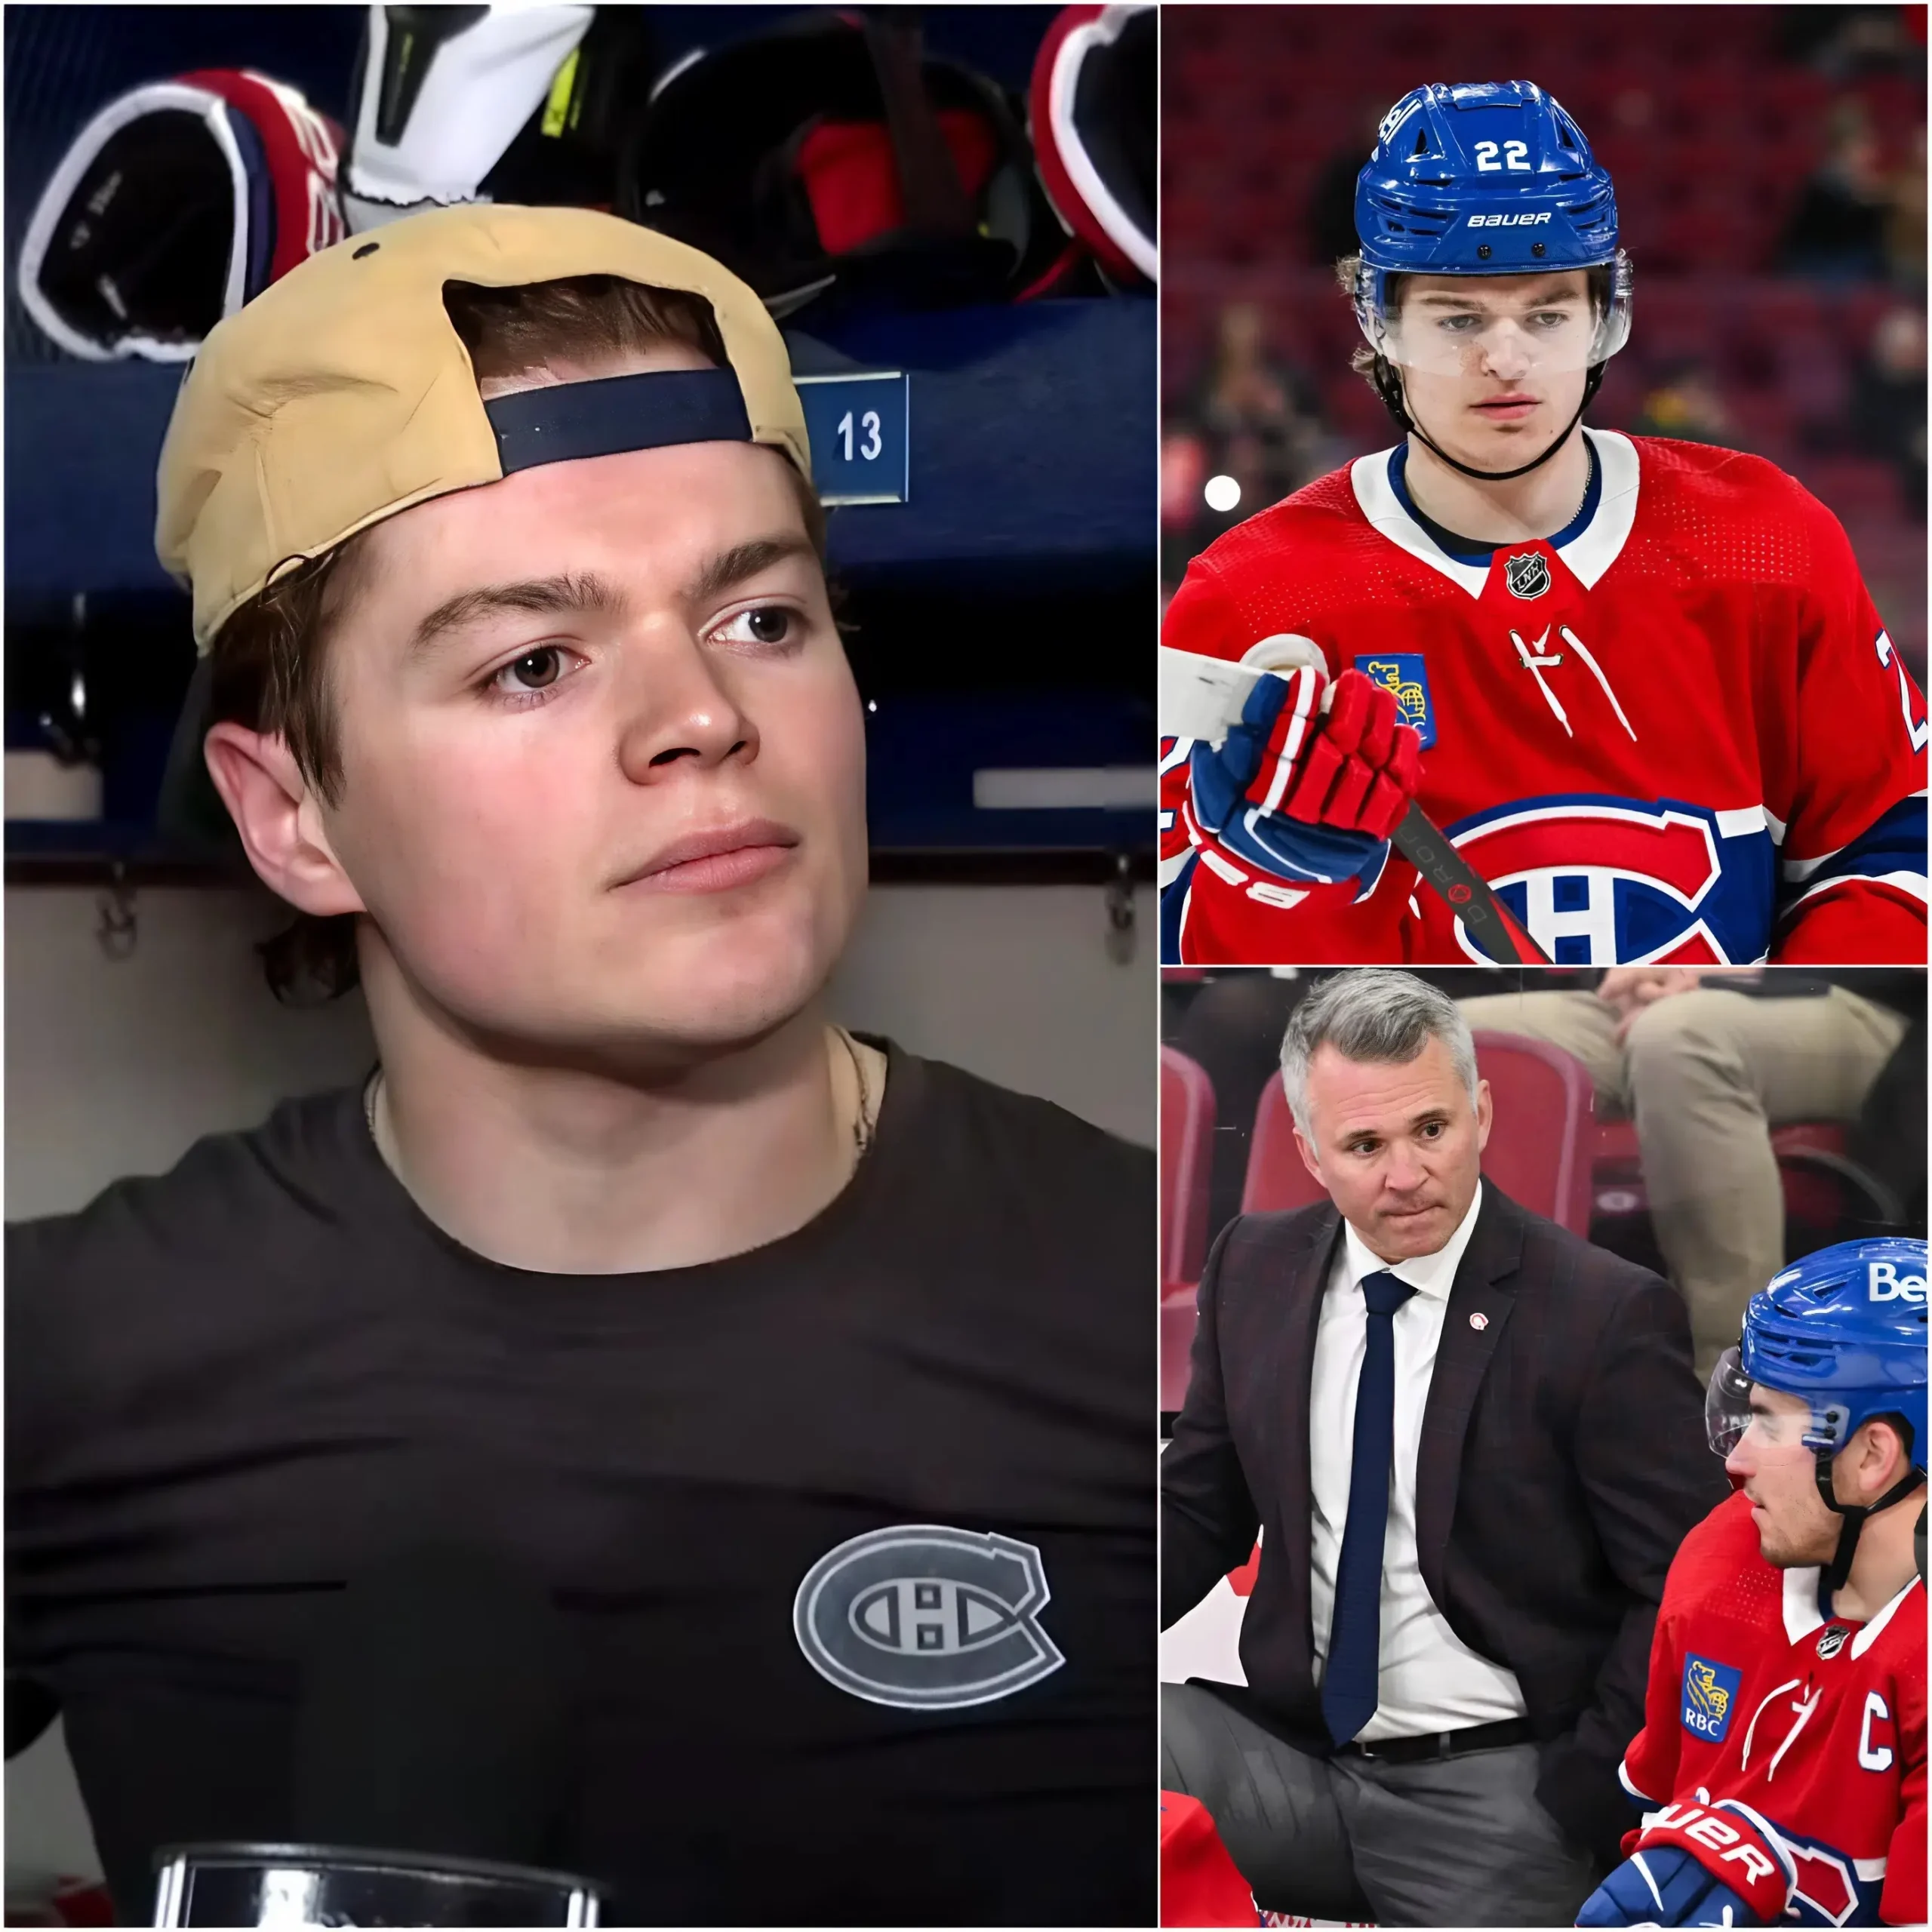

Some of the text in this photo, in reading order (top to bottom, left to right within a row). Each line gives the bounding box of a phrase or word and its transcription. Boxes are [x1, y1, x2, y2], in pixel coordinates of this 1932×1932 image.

[1474, 140, 1531, 172] 22
[1467, 211, 1552, 227] BAUER
[838, 411, 882, 461] 13
[1869, 1262, 1928, 1303] Be
[1684, 1707, 1721, 1737] RBC
[1857, 1690, 1894, 1773] C
